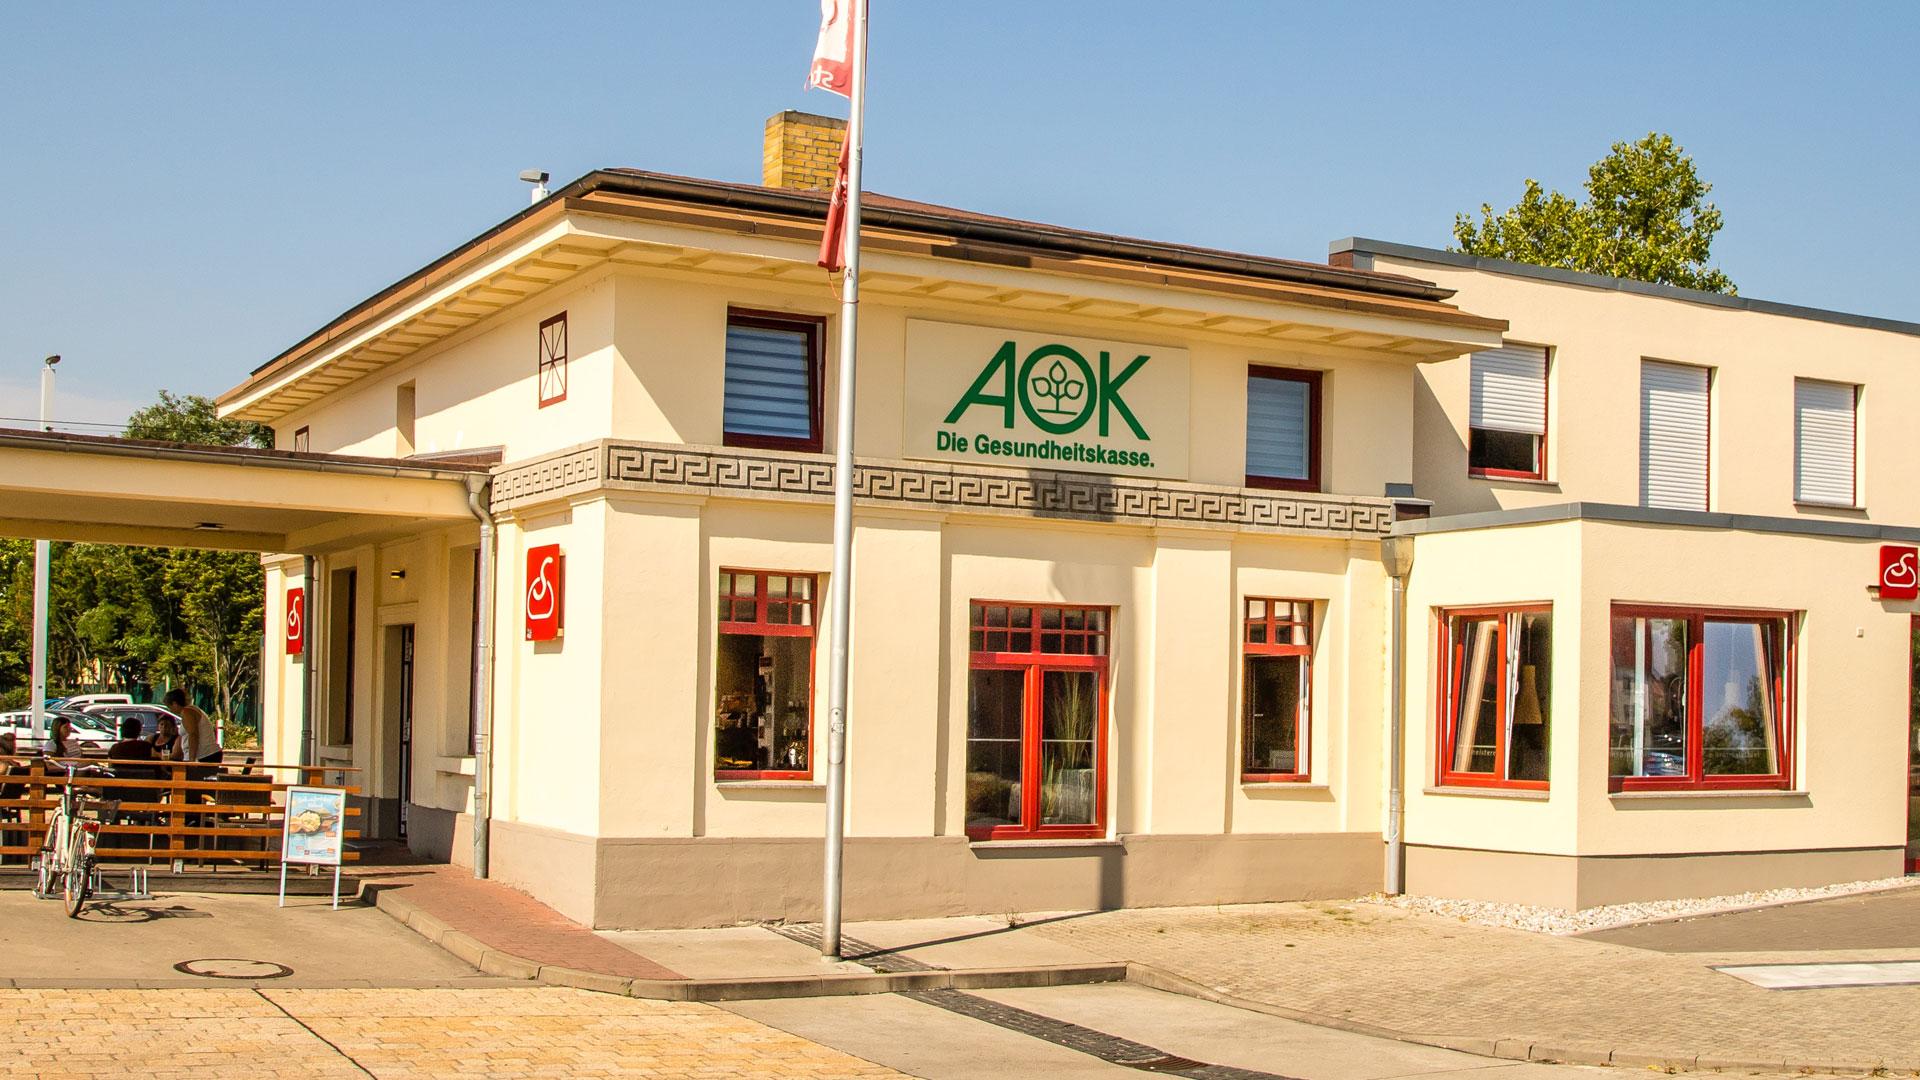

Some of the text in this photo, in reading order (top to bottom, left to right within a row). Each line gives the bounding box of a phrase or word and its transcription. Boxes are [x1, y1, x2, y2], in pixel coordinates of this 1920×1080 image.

[944, 341, 1151, 441] AOK
[936, 430, 1155, 468] Die Gesundheitskasse.
